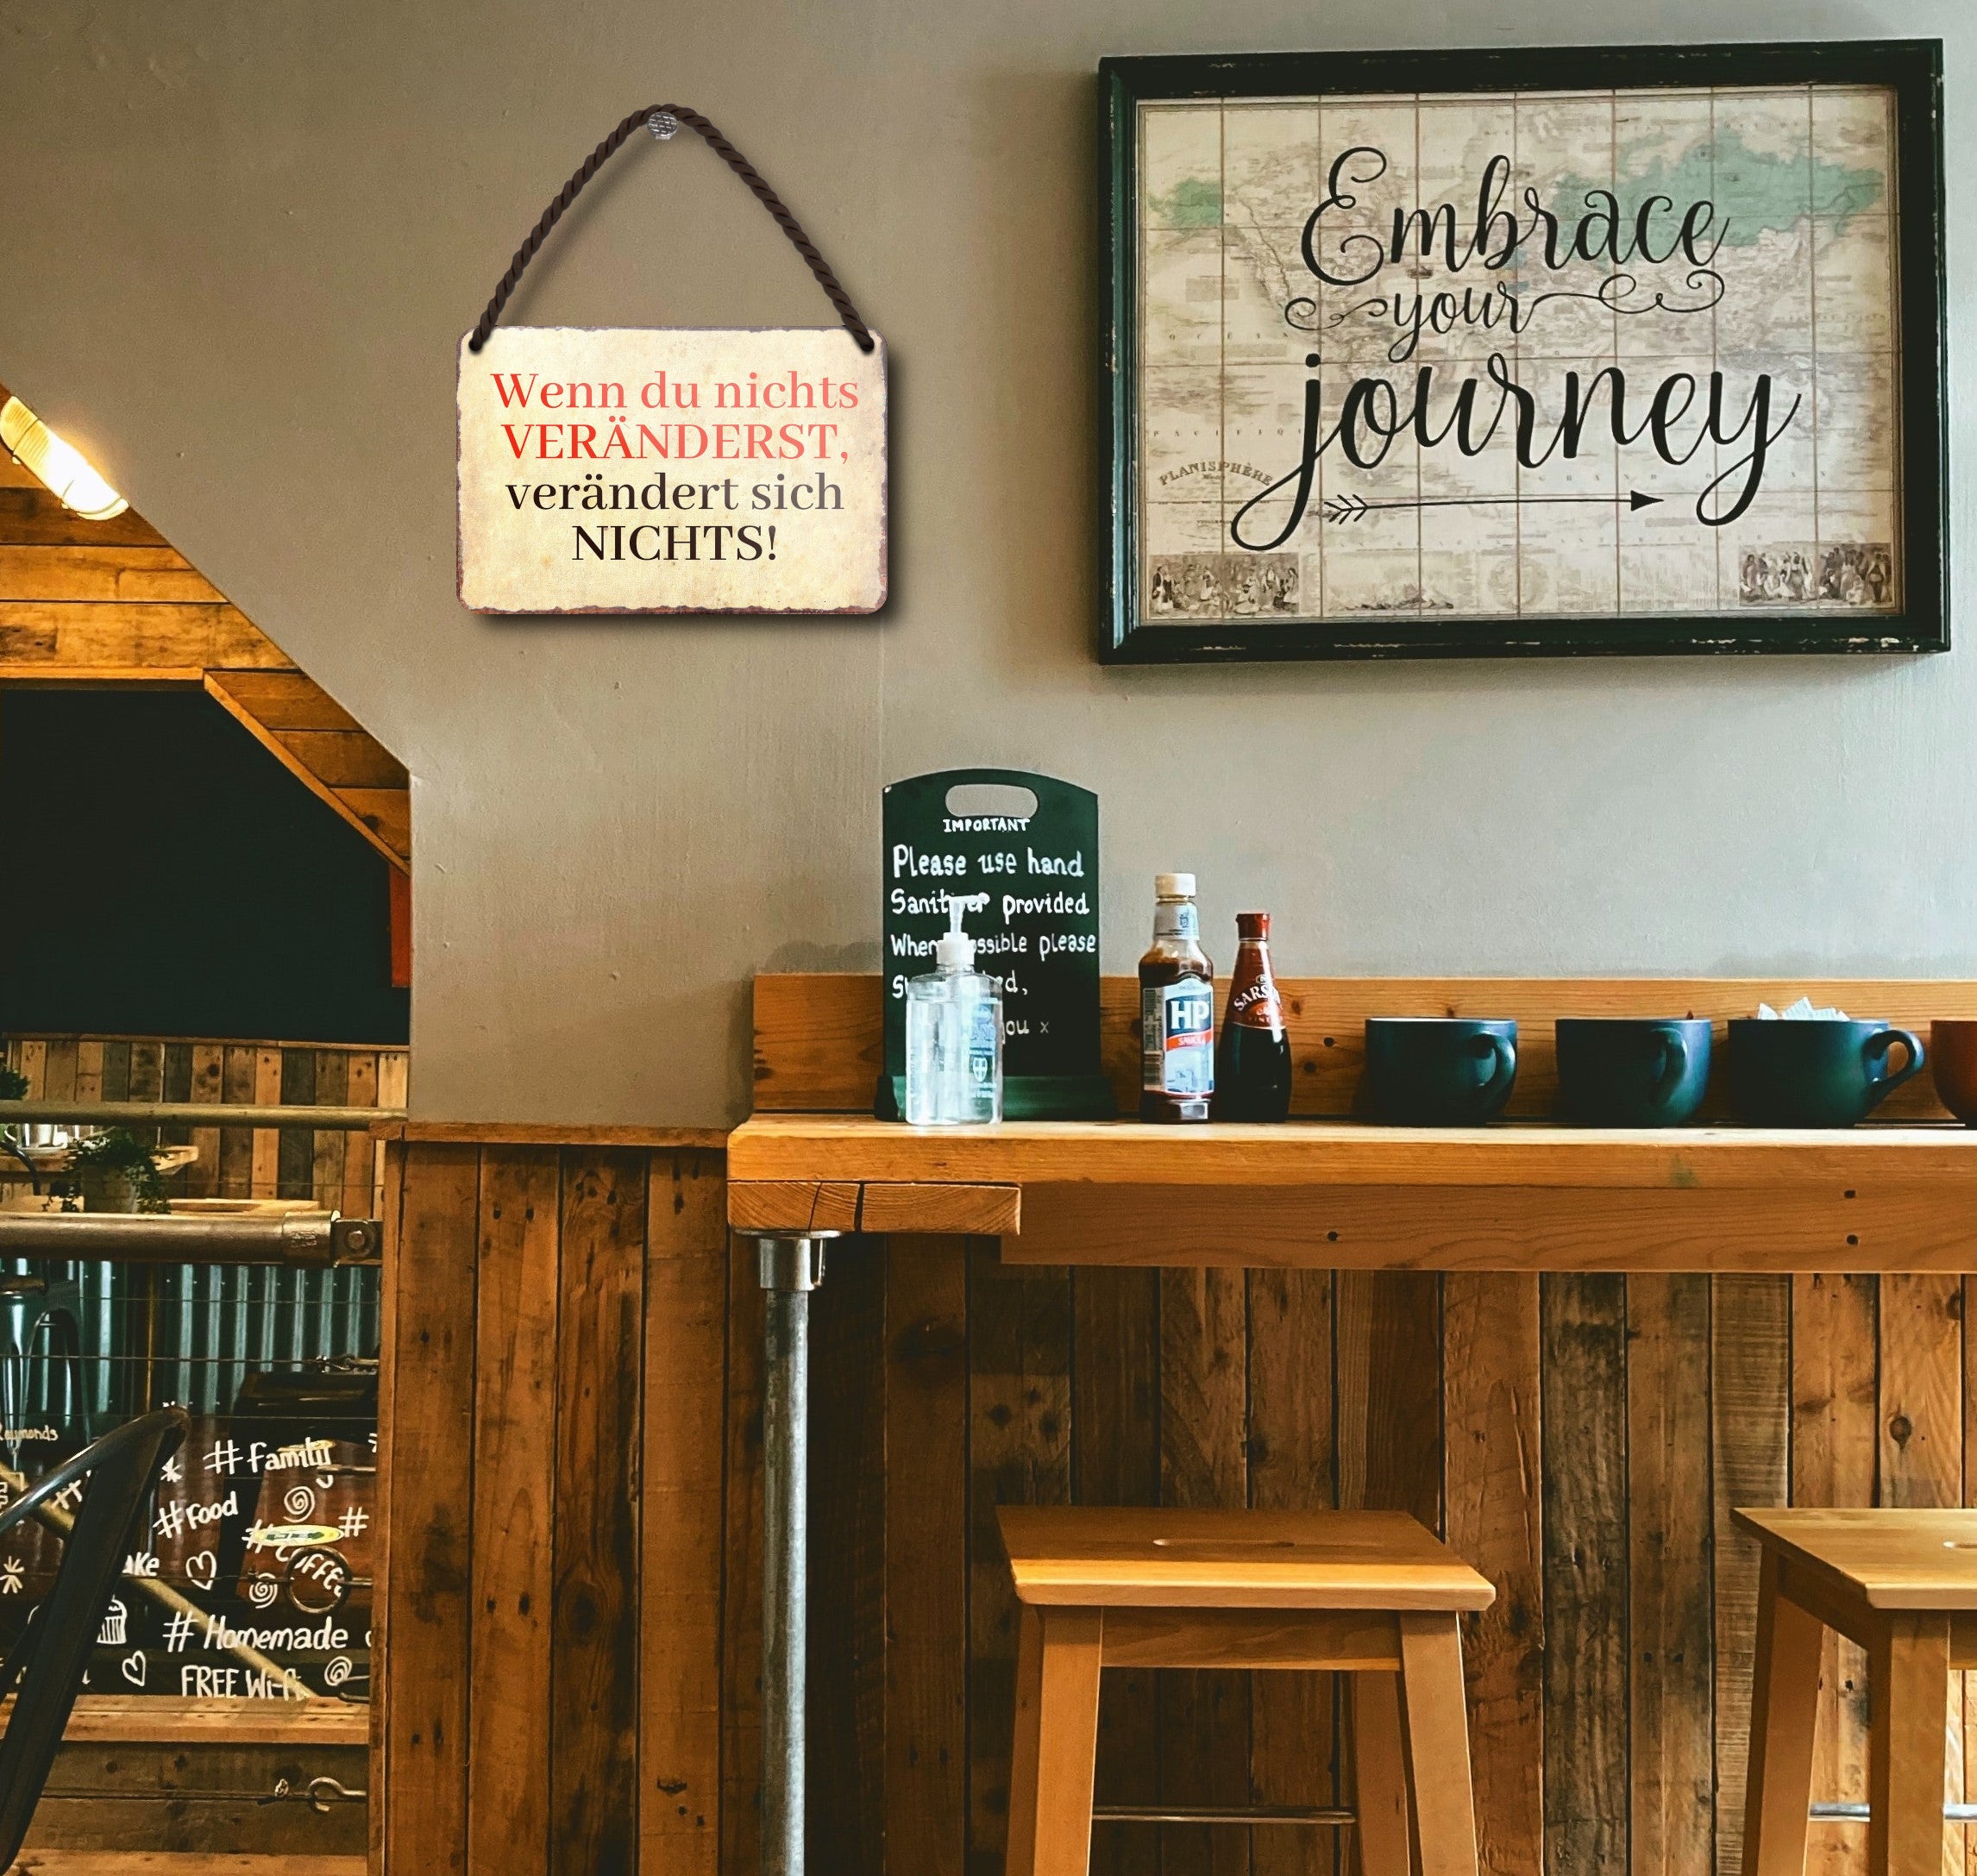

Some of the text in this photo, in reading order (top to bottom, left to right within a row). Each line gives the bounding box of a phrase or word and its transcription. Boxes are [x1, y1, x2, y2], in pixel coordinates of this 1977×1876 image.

[1301, 146, 1731, 286] Embrace
[490, 370, 859, 409] Wenn du nichts
[501, 415, 849, 464] VERÄNDERST,
[1231, 352, 1802, 551] journey
[1159, 461, 1274, 486] PLANISPHÈRE
[505, 472, 845, 511] verändert sich
[571, 524, 777, 562] NICHTS!
[942, 818, 1031, 833] IMPORTANT
[893, 844, 1085, 878] Please use hand
[1002, 890, 1090, 925] provided
[1039, 933, 1096, 962] please
[1171, 1001, 1209, 1030] HP
[181, 1664, 240, 1699] FREE
